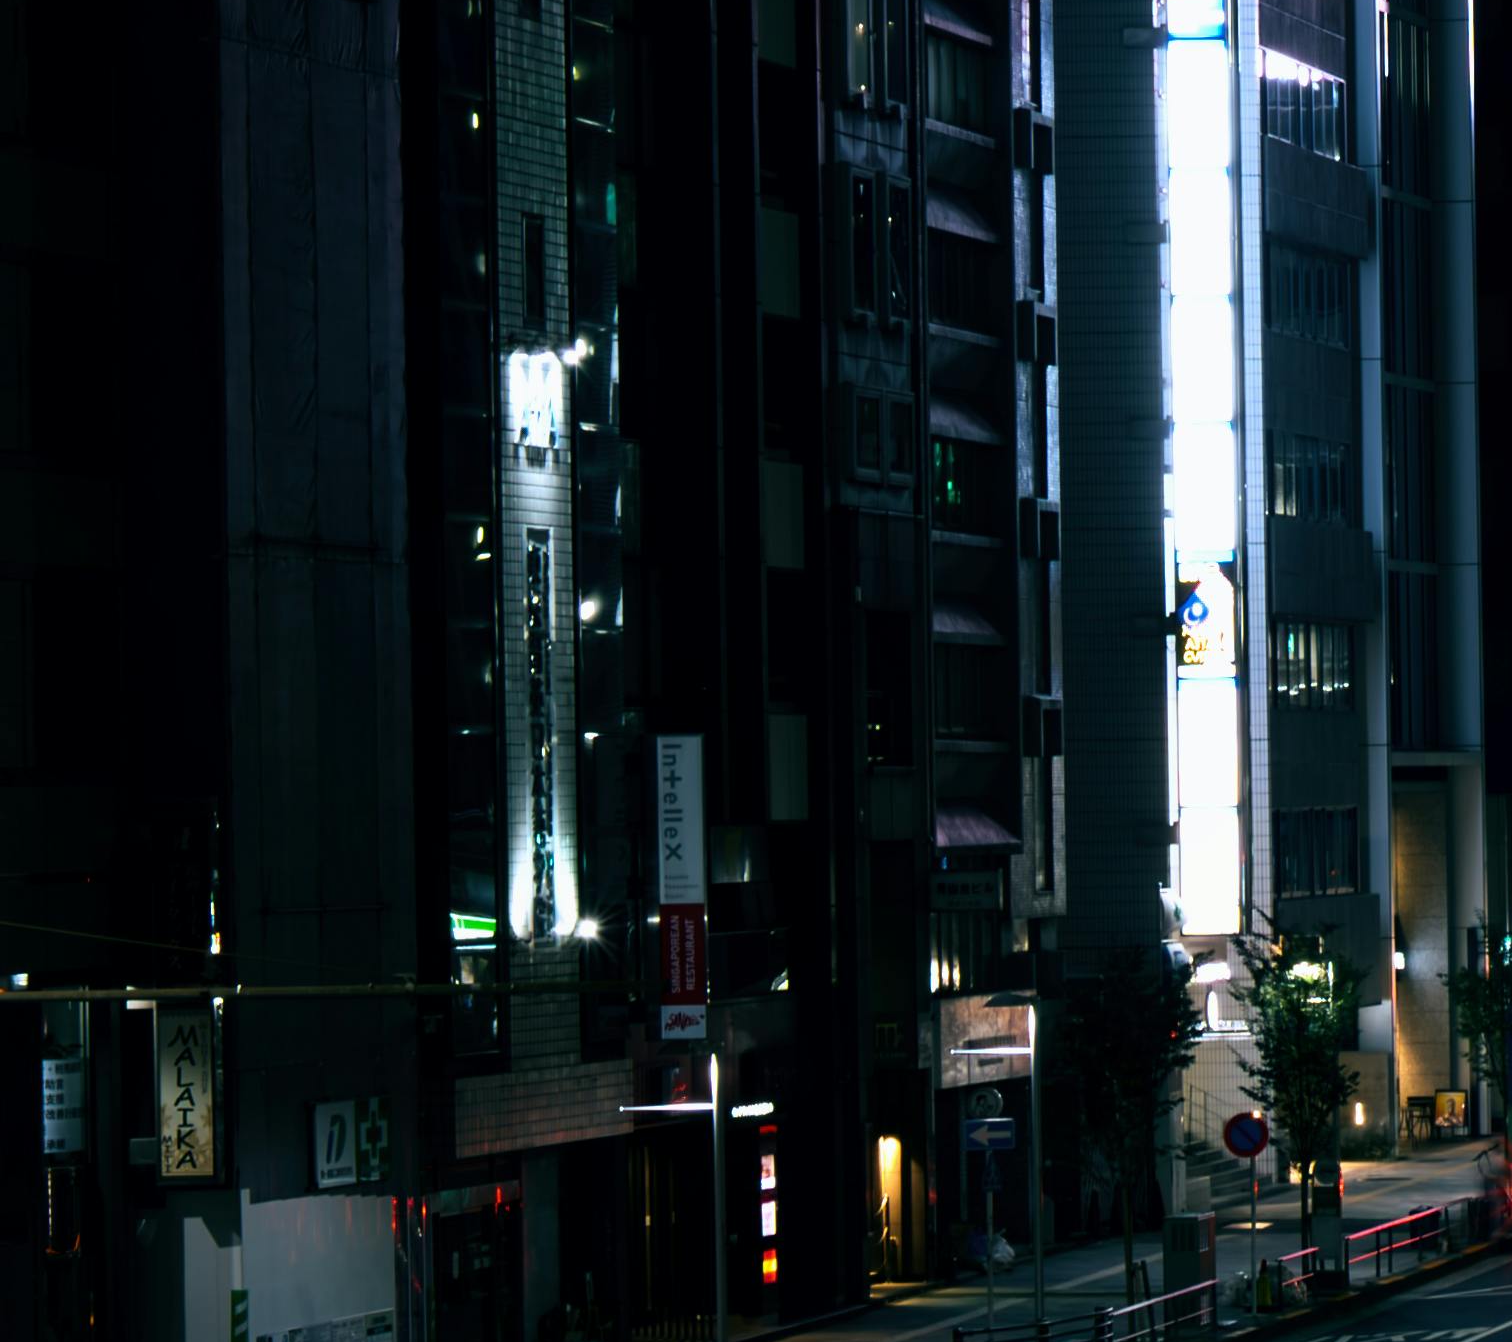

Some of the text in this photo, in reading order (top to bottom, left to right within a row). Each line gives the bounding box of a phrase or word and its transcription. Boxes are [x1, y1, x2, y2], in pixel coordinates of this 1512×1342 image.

[671, 915, 681, 995] SINGAPOREAN
[685, 918, 696, 992] RESTAURANT
[168, 1024, 199, 1170] MALAIKA
